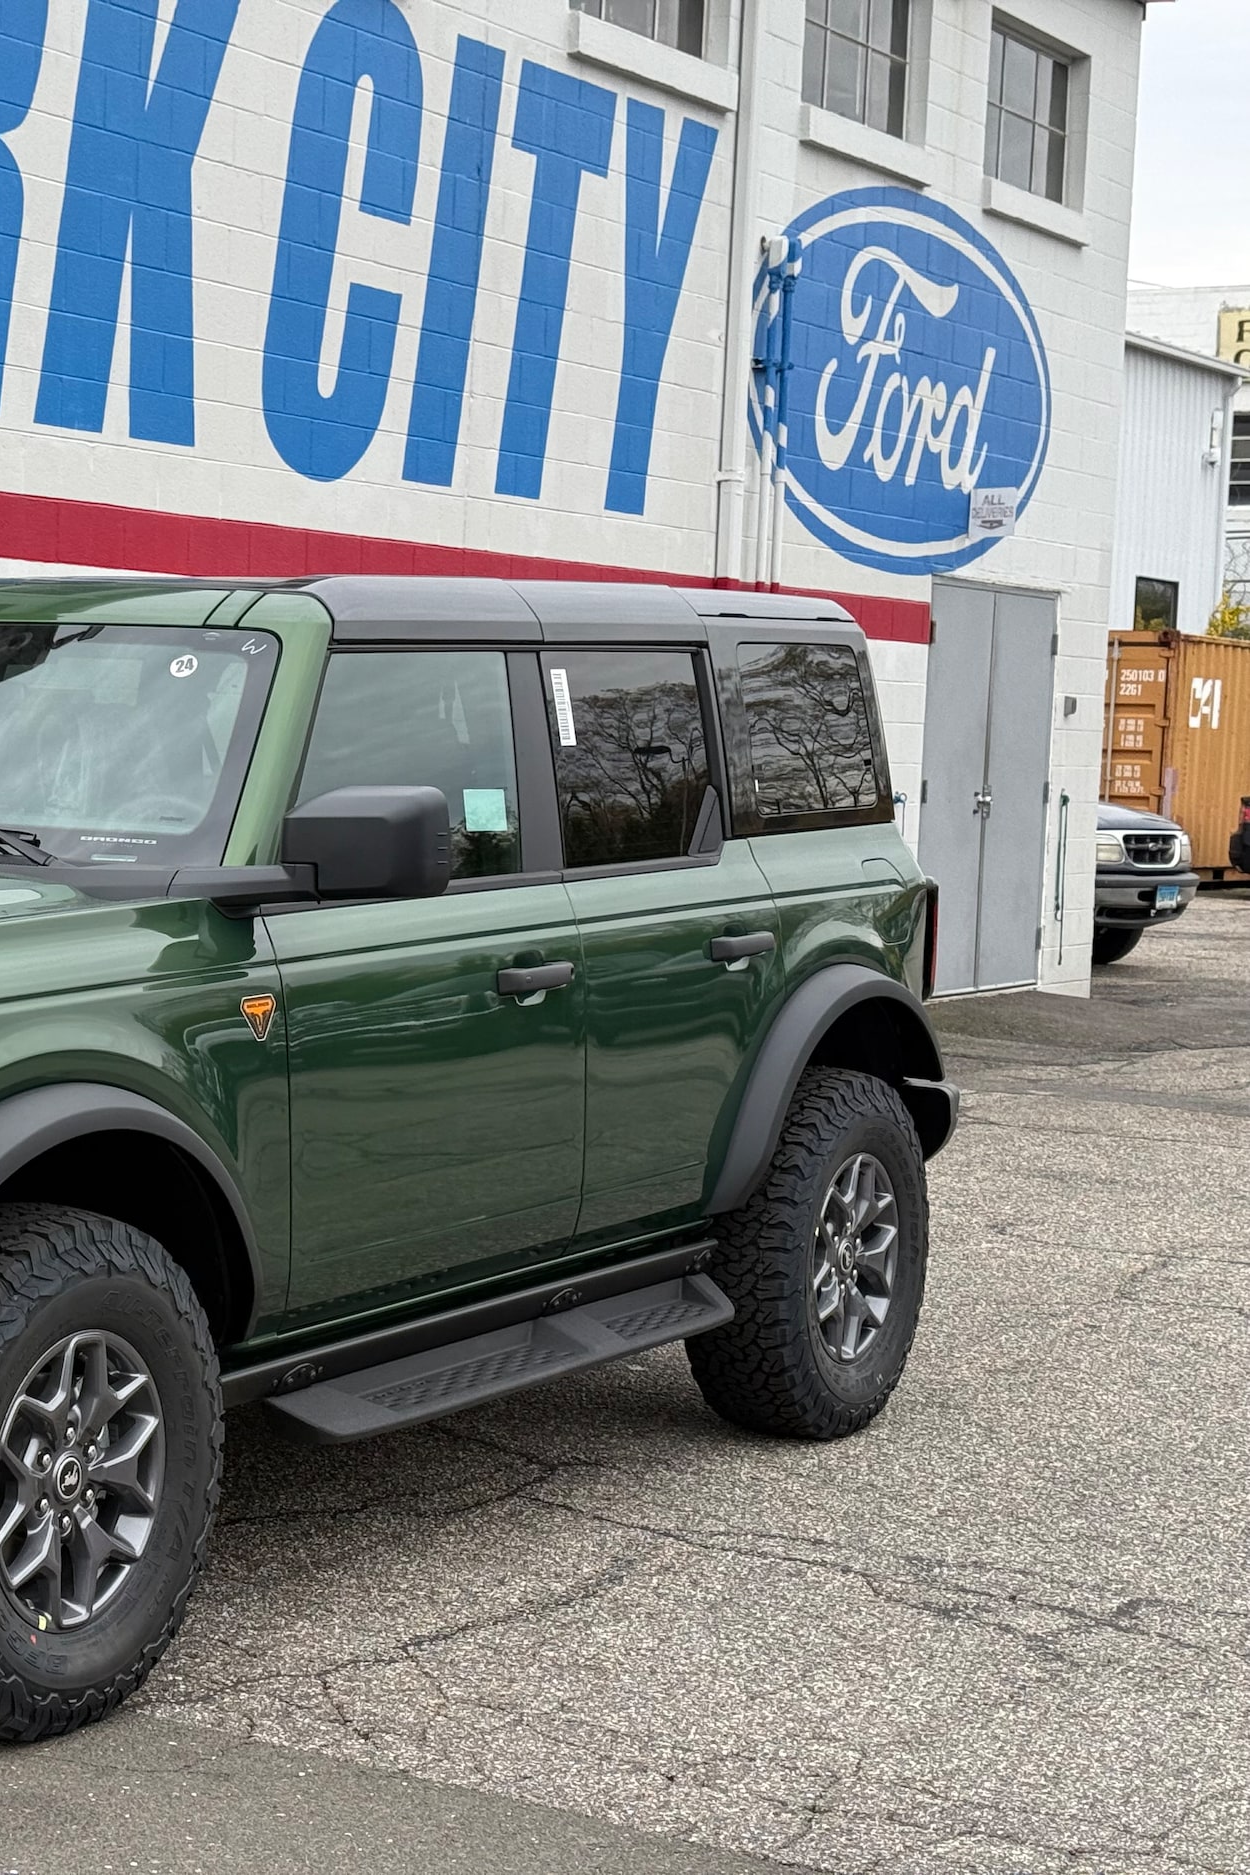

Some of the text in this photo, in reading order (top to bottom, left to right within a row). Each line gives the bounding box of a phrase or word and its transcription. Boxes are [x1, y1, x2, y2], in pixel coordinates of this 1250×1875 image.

[262, 0, 718, 516] CITY
[815, 245, 996, 494] Ford
[982, 494, 1005, 506] ALL
[175, 658, 194, 673] 24
[1120, 669, 1155, 682] 250103
[80, 836, 157, 845] BRONCO
